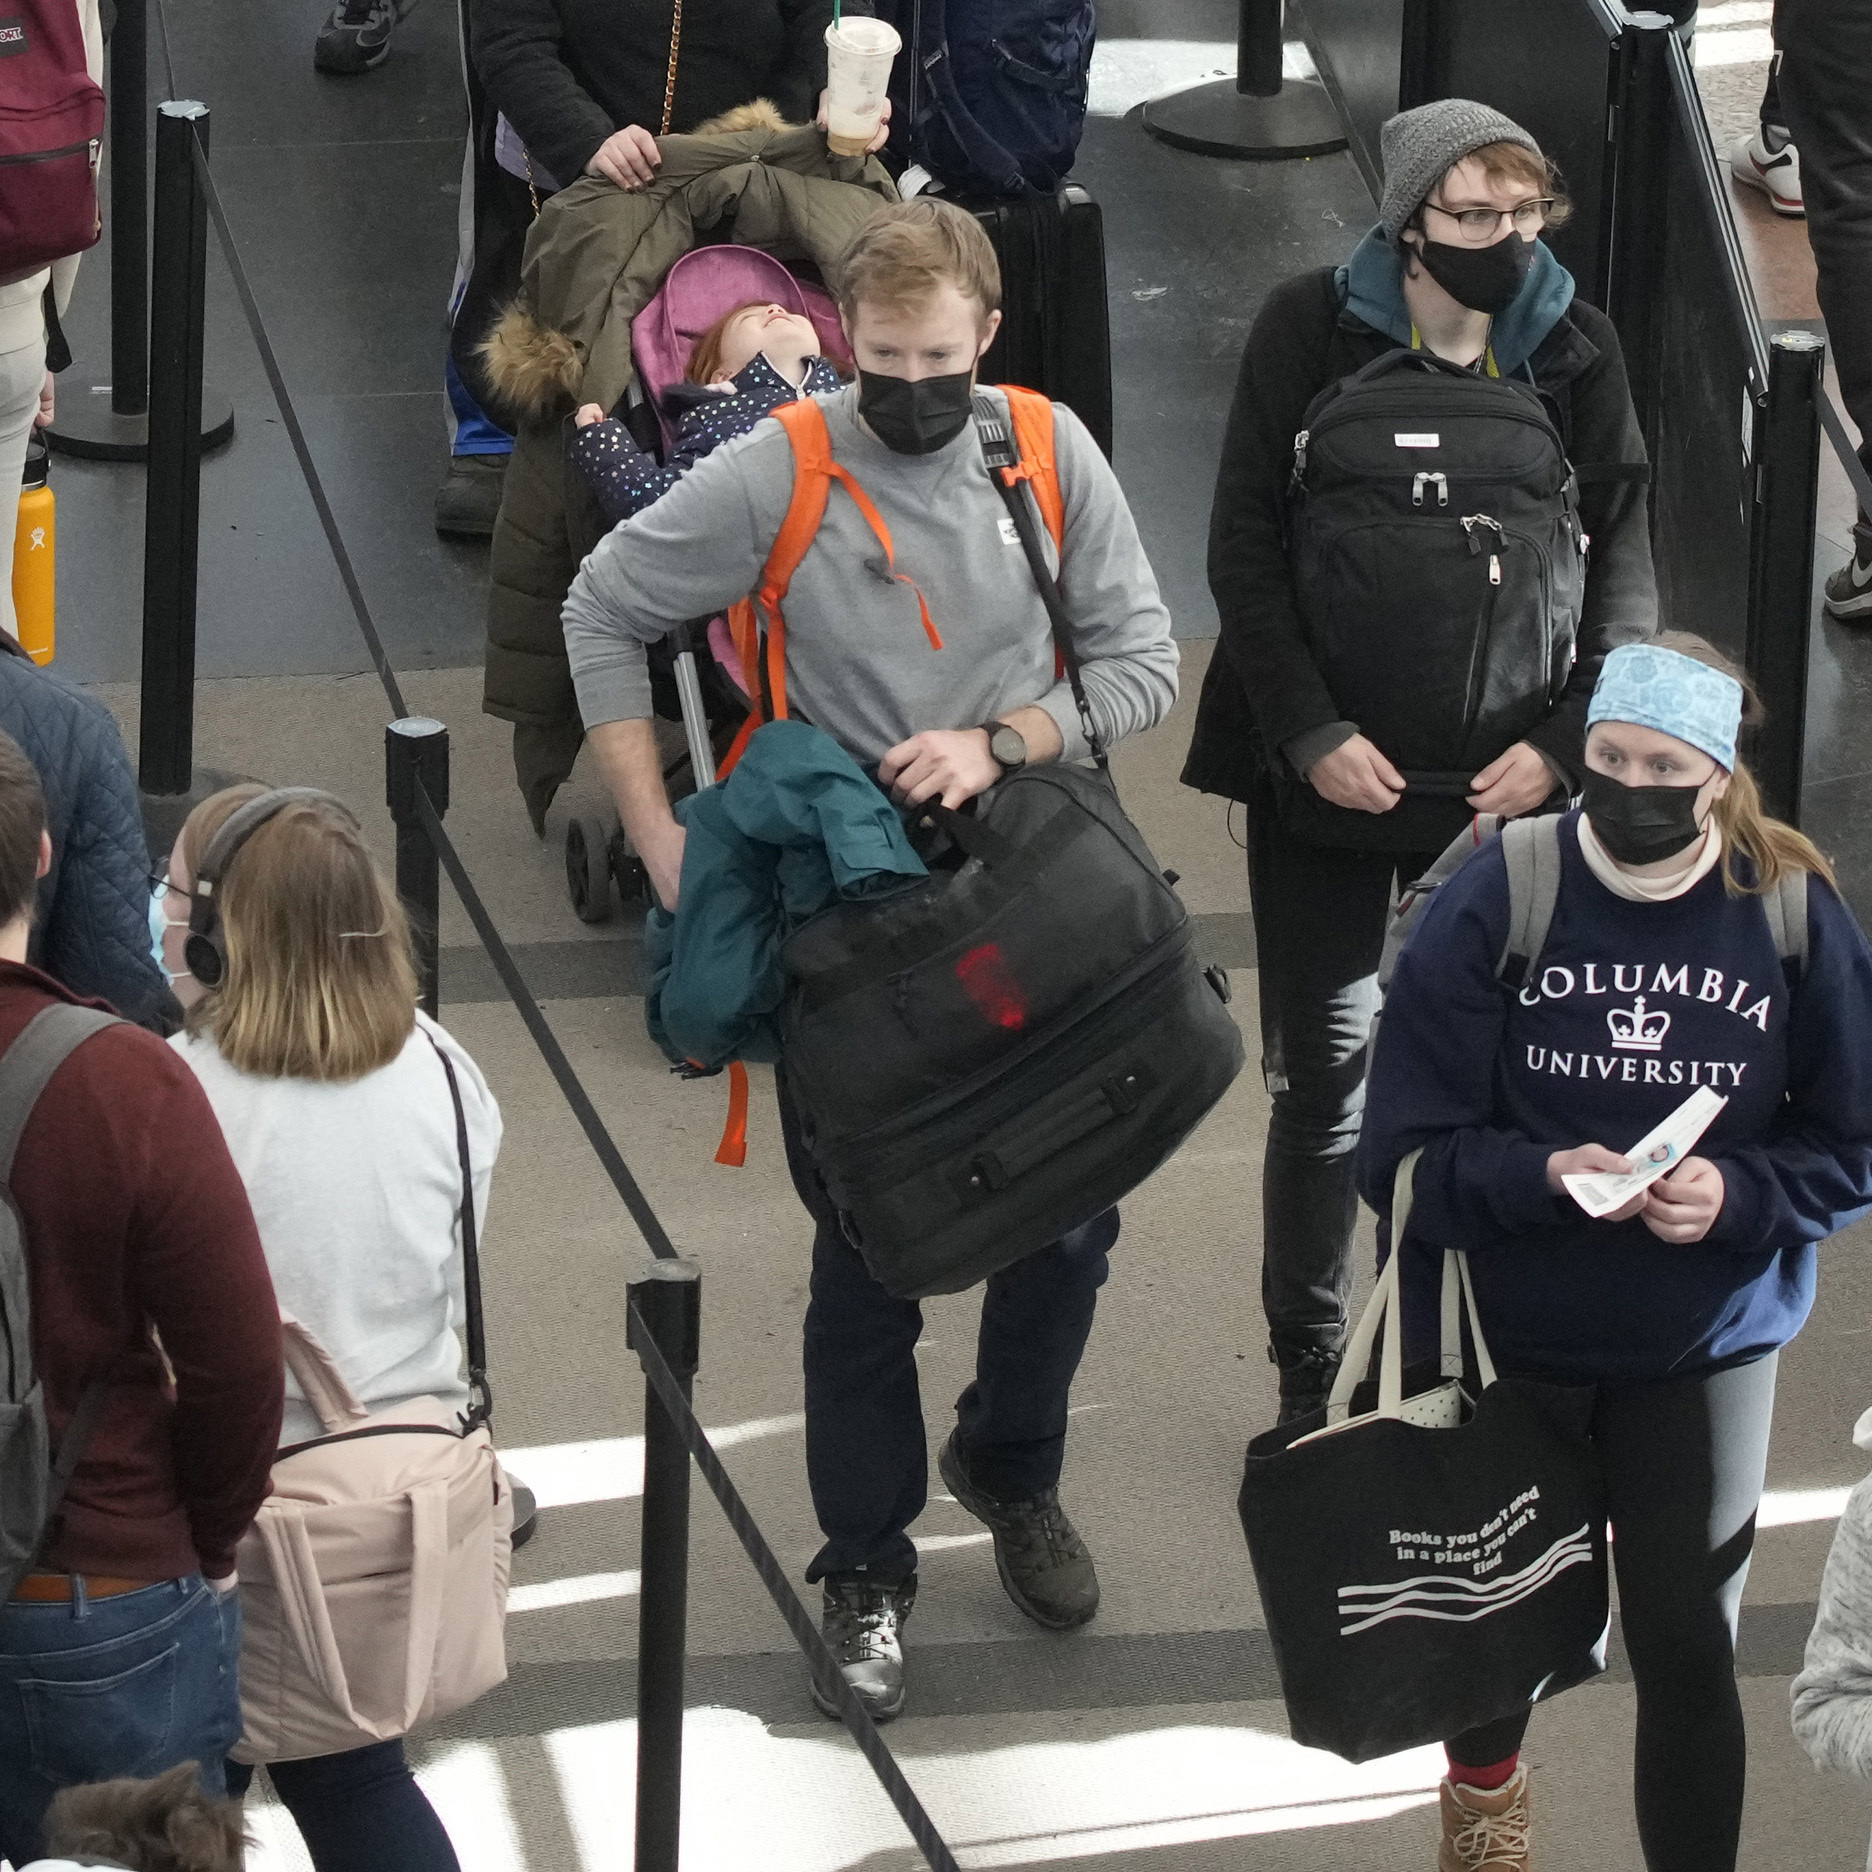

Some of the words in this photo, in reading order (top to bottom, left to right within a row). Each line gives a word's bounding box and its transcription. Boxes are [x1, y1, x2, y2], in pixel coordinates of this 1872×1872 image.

[1518, 962, 1772, 1033] COLUMBIA
[1526, 1044, 1749, 1087] UNIVERSITY
[1389, 1529, 1442, 1545] Books
[1446, 1532, 1478, 1548] you
[1479, 1508, 1509, 1539] don't
[1509, 1485, 1540, 1515] need
[1397, 1547, 1416, 1560] in
[1419, 1550, 1429, 1560] a
[1434, 1548, 1481, 1564] place
[1483, 1532, 1507, 1558] you
[1506, 1507, 1537, 1538] can't
[1473, 1550, 1503, 1576] find
